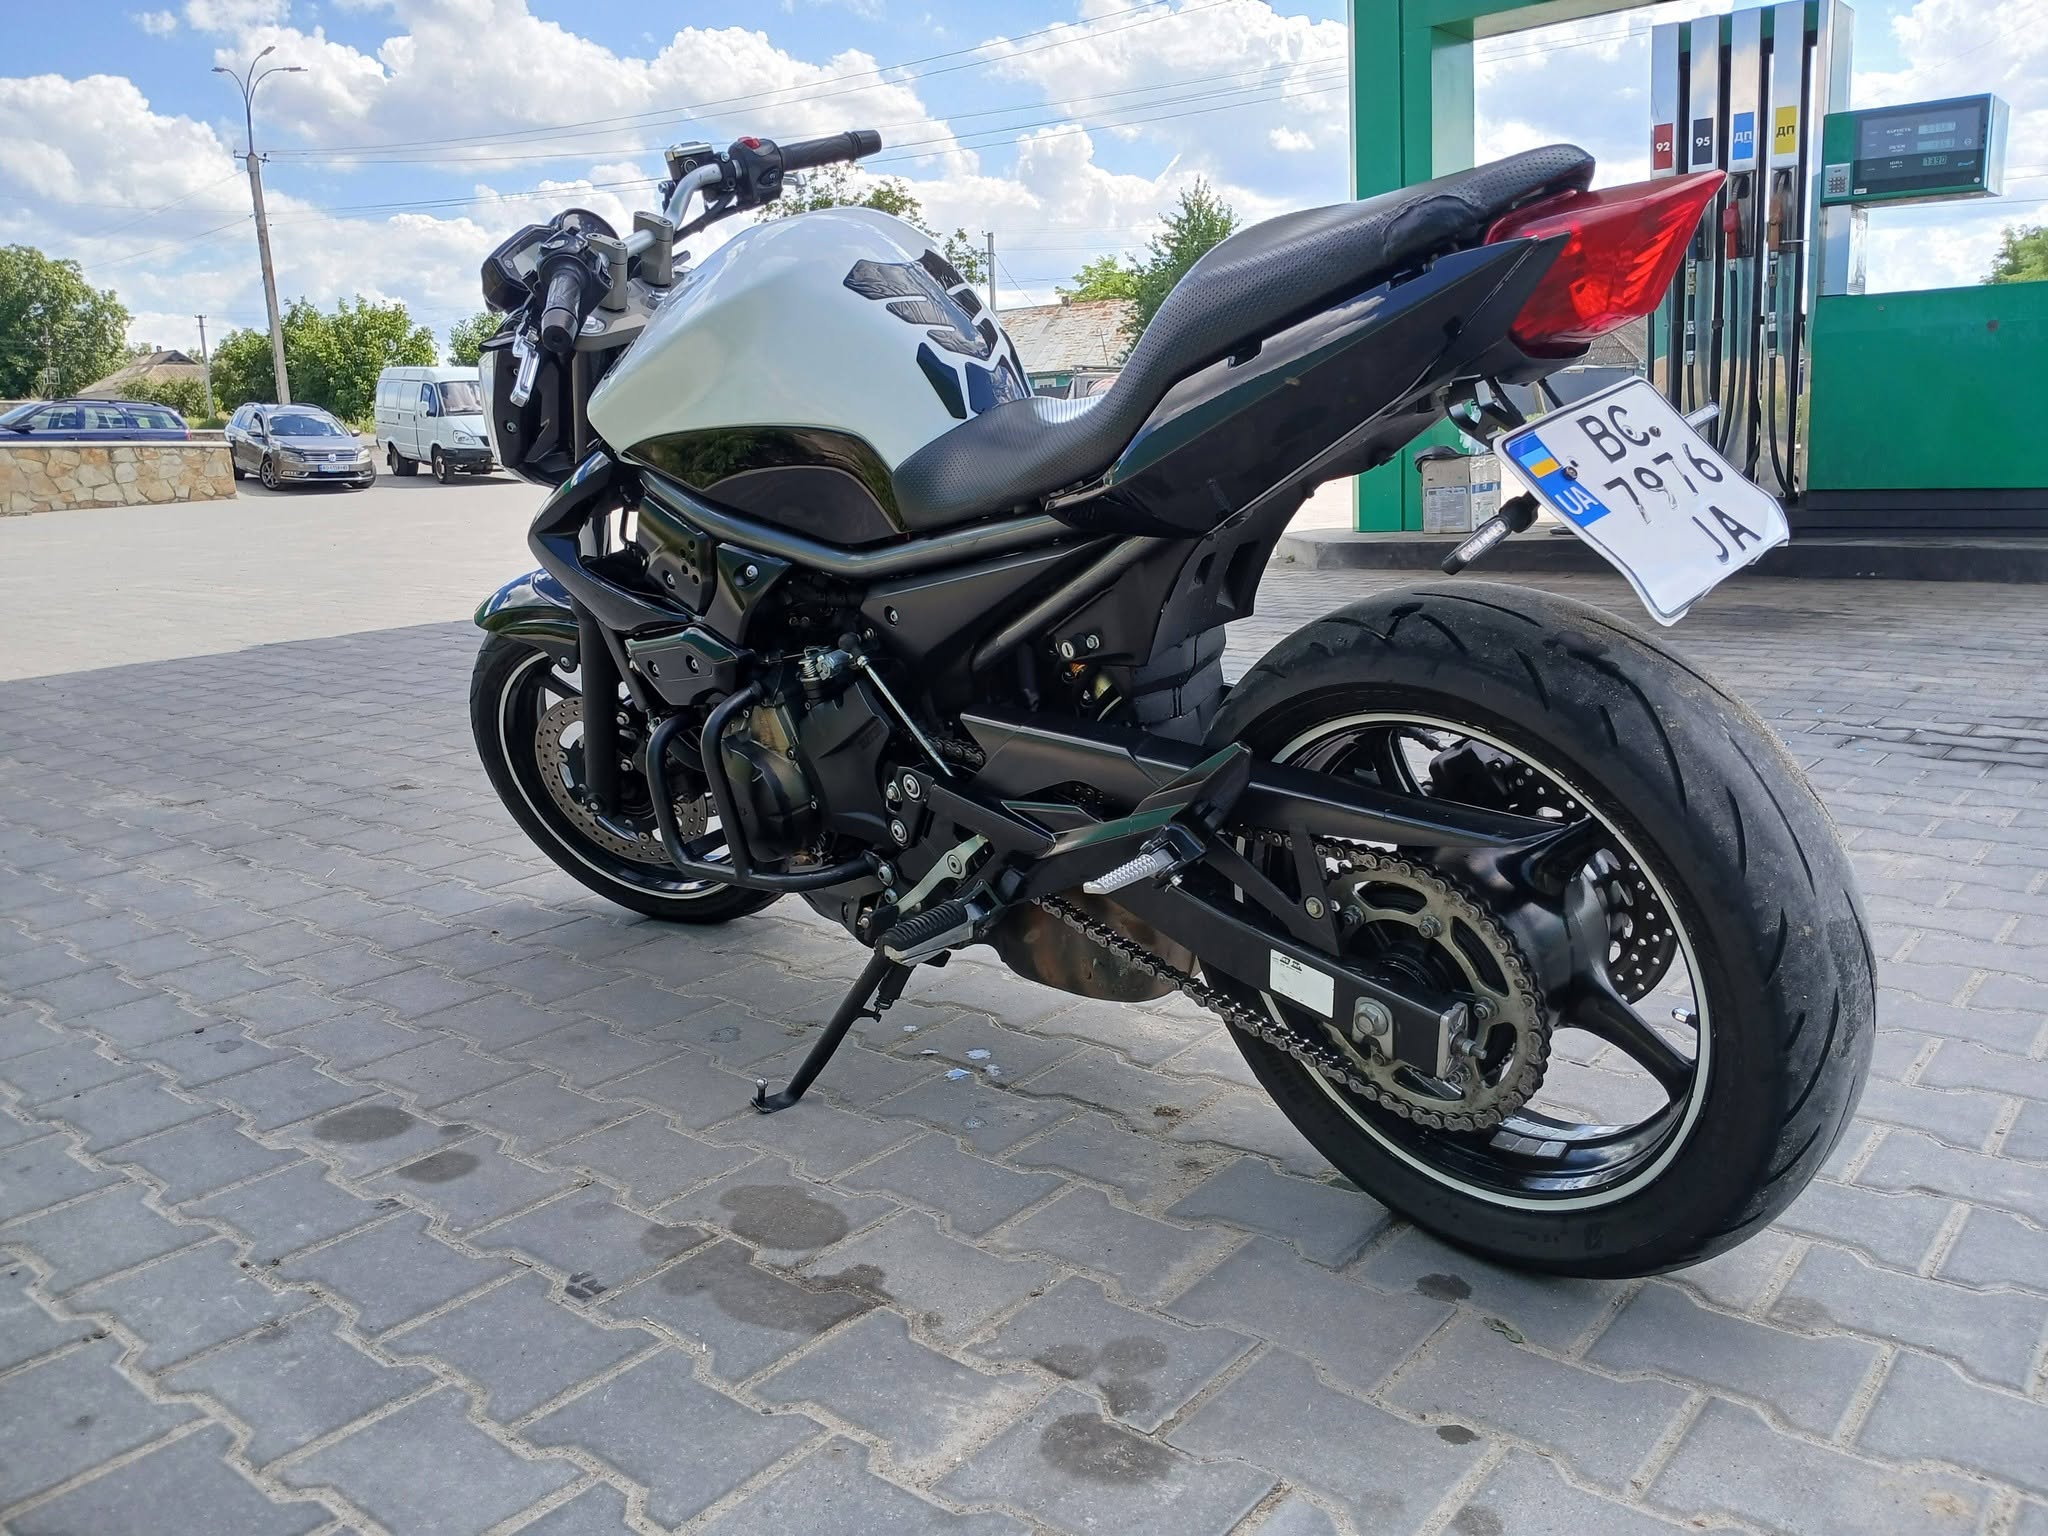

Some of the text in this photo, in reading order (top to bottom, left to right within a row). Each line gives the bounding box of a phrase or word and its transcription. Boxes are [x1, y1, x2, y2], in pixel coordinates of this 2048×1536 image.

[1695, 136, 1710, 147] 95
[1734, 131, 1752, 143] ДП
[1776, 125, 1795, 138] ДП
[1655, 141, 1671, 152] 92
[1576, 405, 1650, 463] BC
[1603, 443, 1723, 525] 7976
[1554, 486, 1599, 515] UA
[1692, 505, 1761, 563] JA
